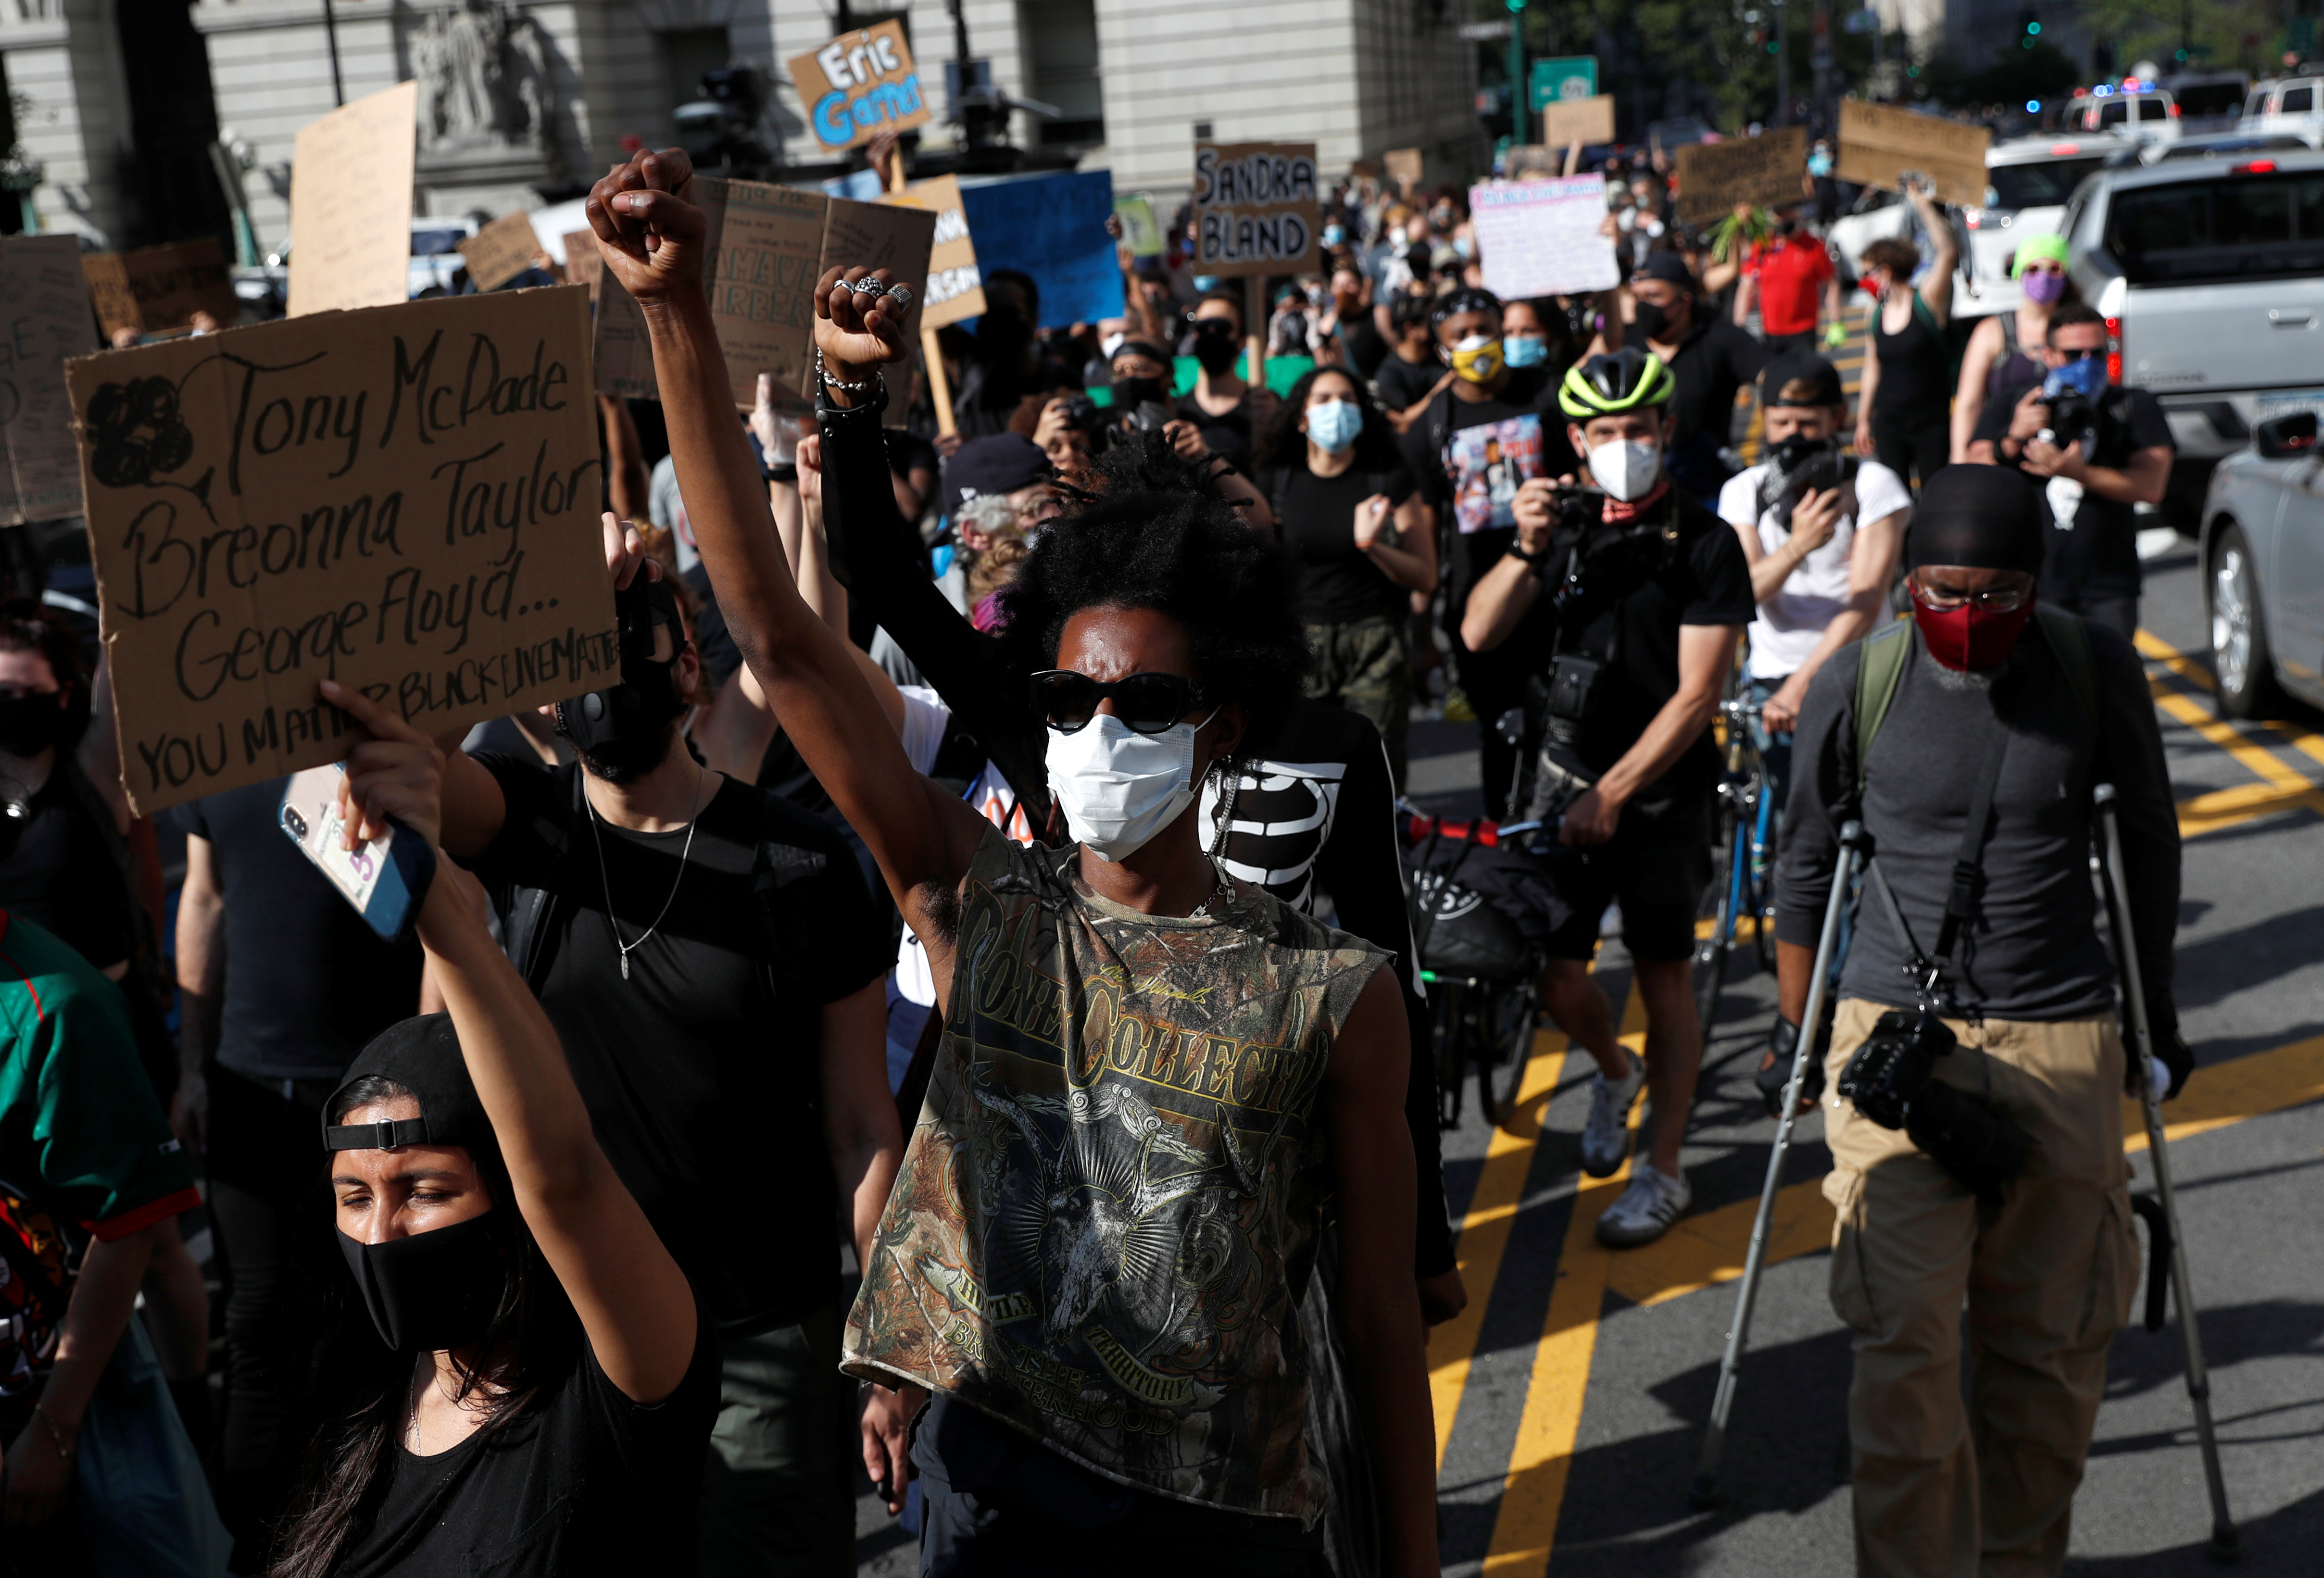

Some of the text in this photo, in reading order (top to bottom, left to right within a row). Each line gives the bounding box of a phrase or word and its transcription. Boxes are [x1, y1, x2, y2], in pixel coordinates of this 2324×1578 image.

[817, 30, 900, 90] Eric
[1196, 147, 1316, 210] SANDRA
[1200, 211, 1310, 263] BLAND
[179, 350, 367, 496] Tony
[379, 328, 568, 449] McDade
[117, 438, 603, 620] Breonna Taylor
[175, 600, 370, 702] George
[137, 723, 228, 792] YOU
[957, 1273, 1037, 1320] HOTILE
[1016, 1344, 1085, 1394] THE
[1085, 1326, 1191, 1402] TERRITORY
